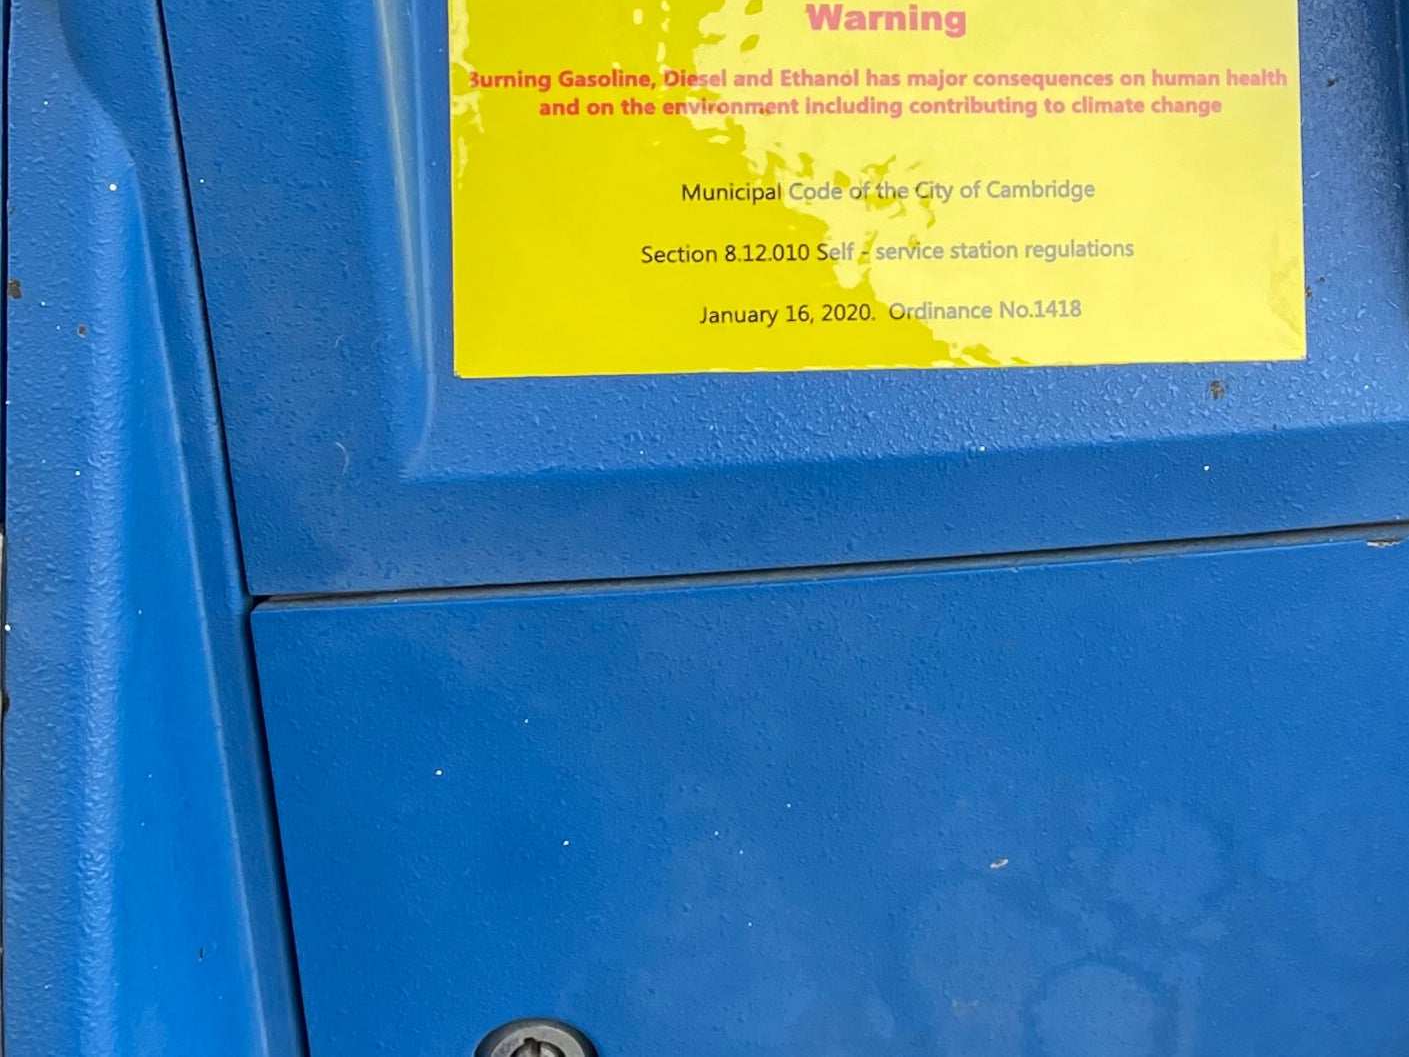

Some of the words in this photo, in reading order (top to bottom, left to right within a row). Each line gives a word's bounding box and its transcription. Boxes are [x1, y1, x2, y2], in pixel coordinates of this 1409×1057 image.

[806, 3, 967, 38] Warning
[558, 70, 656, 90] Gasoline,
[664, 69, 726, 88] Diesel
[733, 69, 773, 88] and
[780, 68, 859, 87] Ethanol
[866, 69, 900, 87] has
[907, 69, 967, 91] major
[973, 71, 1114, 90] consequences
[1119, 73, 1146, 87] on
[1151, 69, 1220, 87] human
[1226, 69, 1288, 87] health
[539, 98, 580, 117] and
[587, 101, 614, 117] on
[620, 97, 655, 116] the
[662, 97, 799, 116] environment
[805, 96, 902, 119] including
[909, 96, 1037, 119] contributing
[1043, 97, 1066, 115] to
[1071, 95, 1145, 115] climate
[1151, 96, 1222, 118] change
[681, 183, 782, 206] Municipal
[788, 182, 843, 202] Code
[849, 181, 871, 201] of
[875, 181, 909, 200] the
[914, 180, 955, 204] City
[960, 180, 983, 200] of
[986, 179, 1096, 204] Cambridge
[641, 245, 718, 265] Section
[724, 243, 810, 263] 8.12.010
[816, 242, 855, 262] Self
[875, 242, 944, 261] service
[950, 241, 1019, 260] station
[1025, 239, 1135, 263] regulations
[699, 305, 778, 328] January
[785, 305, 814, 326] 16,
[821, 303, 877, 323] 2020.
[889, 301, 993, 321] Ordinance
[999, 300, 1082, 319] No.1418
